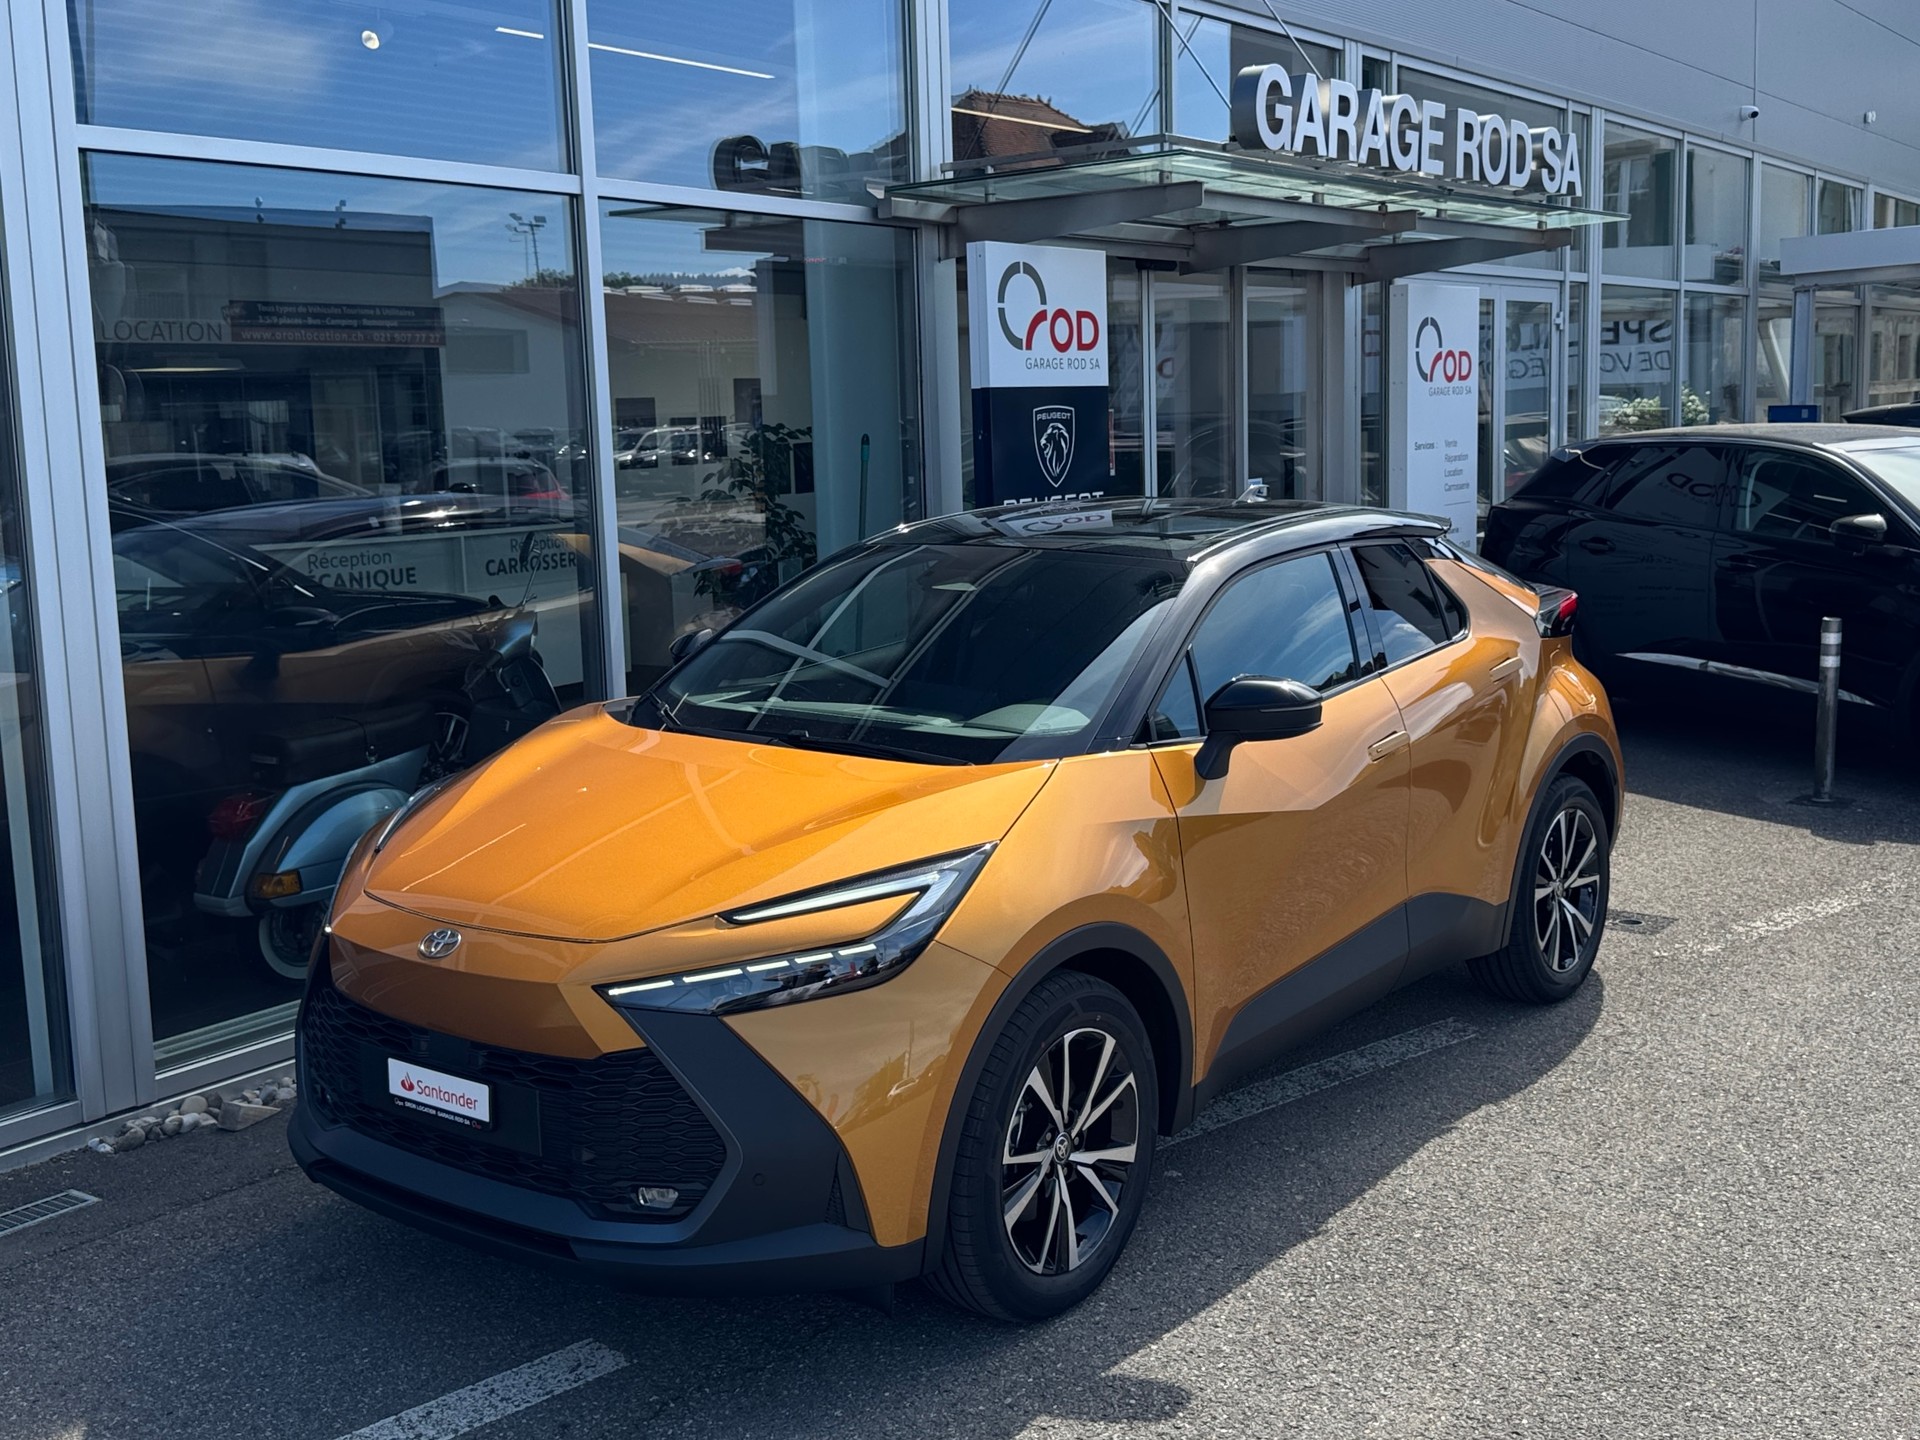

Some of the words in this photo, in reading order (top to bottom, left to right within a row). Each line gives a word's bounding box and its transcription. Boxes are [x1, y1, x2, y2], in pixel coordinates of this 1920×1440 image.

[1255, 63, 1446, 176] GARAGE
[1457, 107, 1534, 189] ROD
[1541, 126, 1583, 198] SA
[101, 319, 223, 342] LOCATION
[241, 328, 364, 342] www.oronlocation.ch
[1025, 357, 1064, 370] GARAGE
[1067, 357, 1087, 370] ROD
[1088, 357, 1100, 370] SA
[1428, 386, 1451, 397] GARAGE
[1452, 386, 1464, 397] ROD
[1465, 385, 1472, 396] SA
[1036, 411, 1071, 421] PEUGEOT
[1414, 441, 1435, 451] Services
[1444, 439, 1458, 448] Vente
[1444, 467, 1463, 478] Location
[307, 550, 392, 570] Réception
[416, 1079, 479, 1111] Santander
